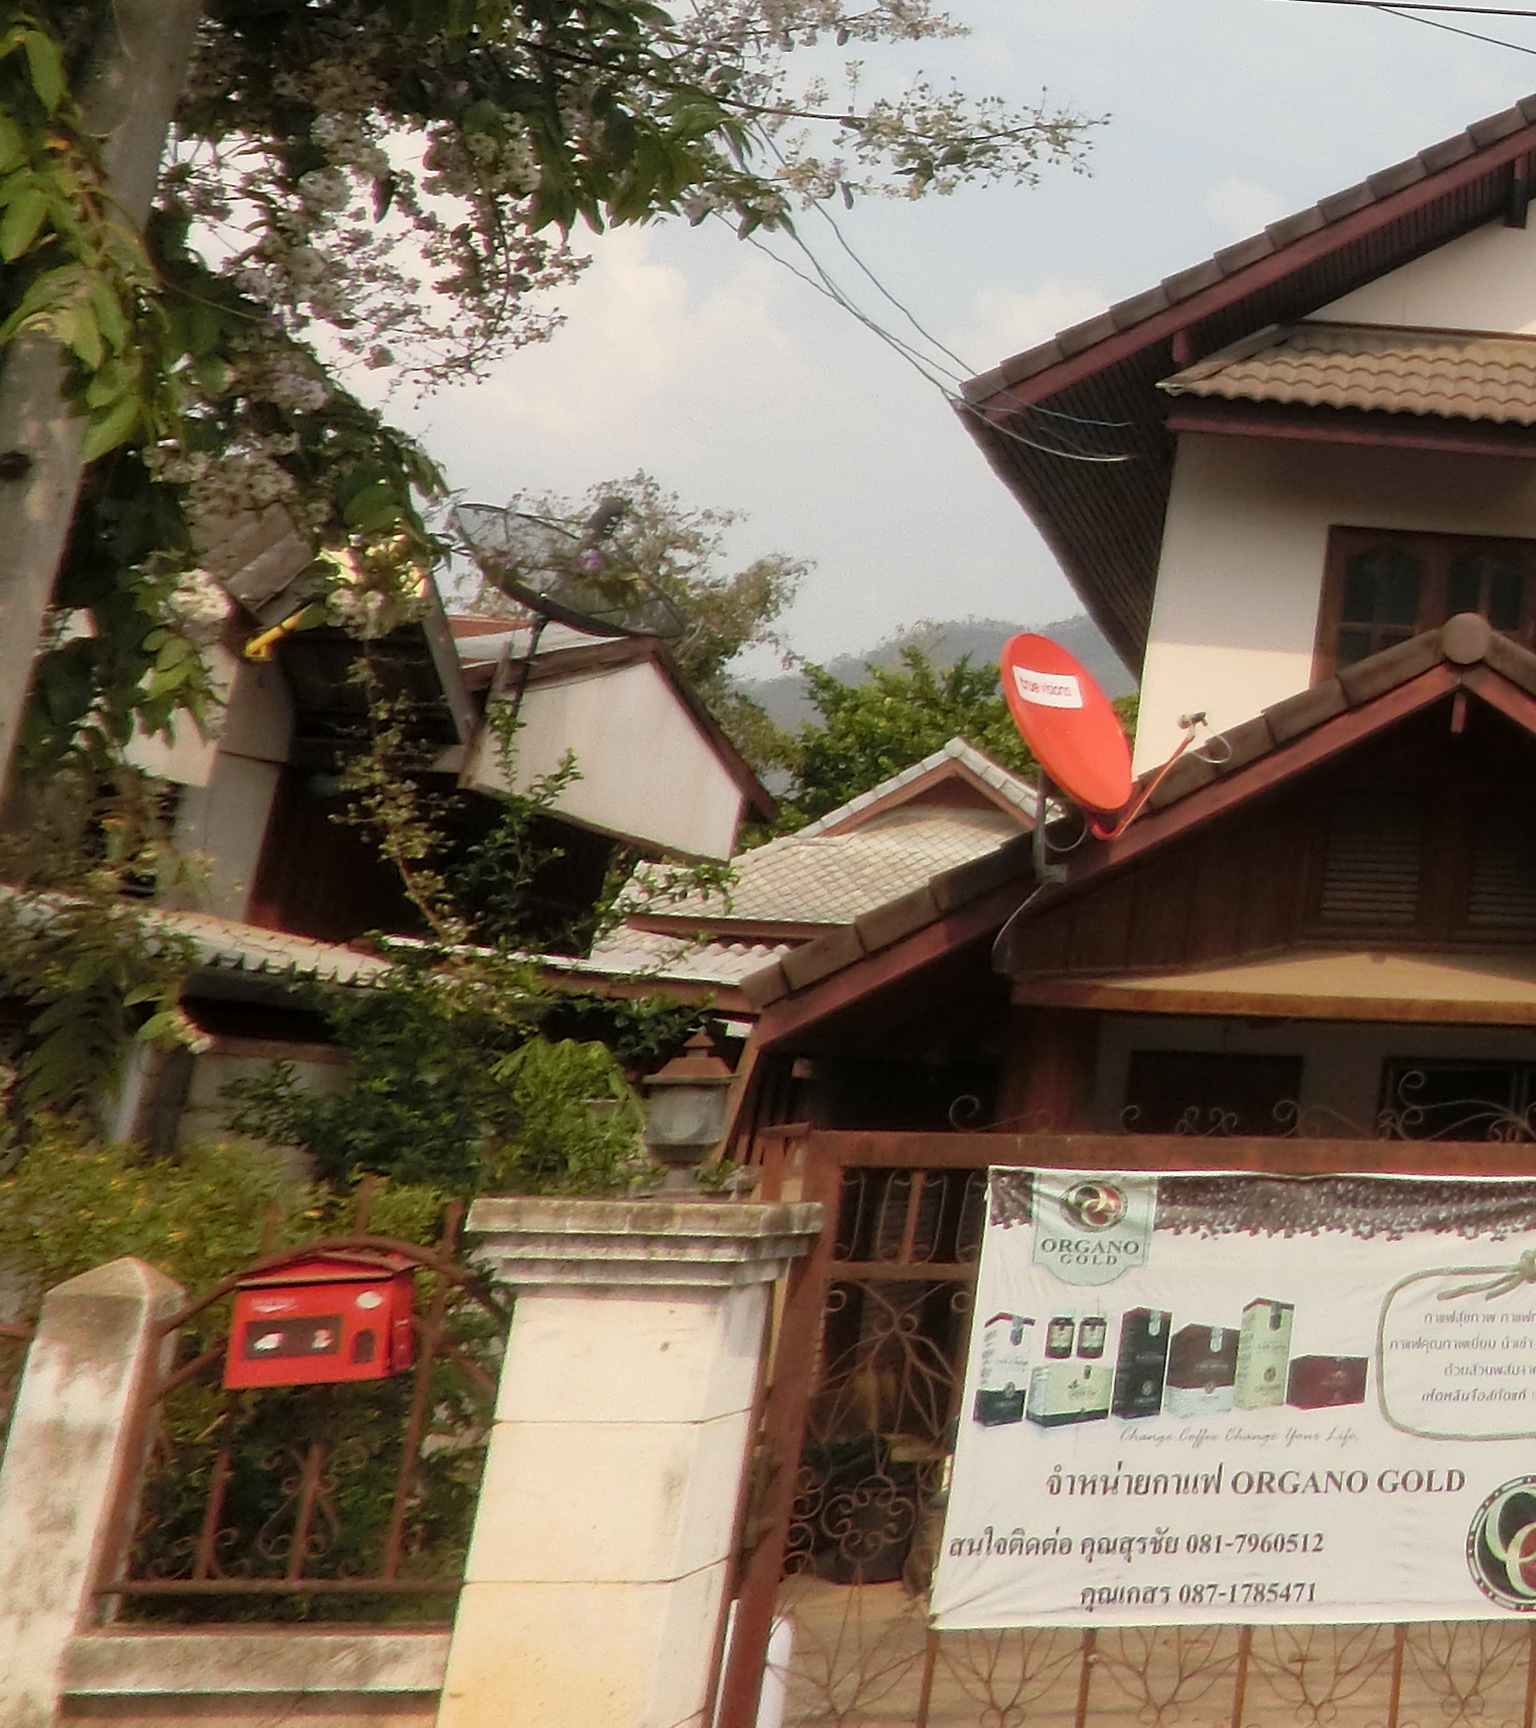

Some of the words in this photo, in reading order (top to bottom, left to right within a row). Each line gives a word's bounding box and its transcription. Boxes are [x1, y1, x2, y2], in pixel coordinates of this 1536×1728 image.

[1041, 1237, 1140, 1255] ORGANO
[1060, 1254, 1118, 1266] GOLD
[1119, 1426, 1173, 1448] Change
[1178, 1426, 1218, 1450] Coffee
[1224, 1426, 1280, 1447] Change
[1286, 1426, 1320, 1448] Your
[1045, 1461, 1224, 1497] จำหน่ายกาแฟ
[1230, 1469, 1369, 1495] ORGANO
[1376, 1468, 1467, 1494] GOLD
[948, 1525, 1072, 1558] สนใจติดต่อ
[1080, 1527, 1179, 1564] คุณสุรชัย
[1186, 1532, 1324, 1555] 081-7960512
[1080, 1583, 1170, 1612] คุณเกสร
[1178, 1581, 1317, 1605] 087-1785471
